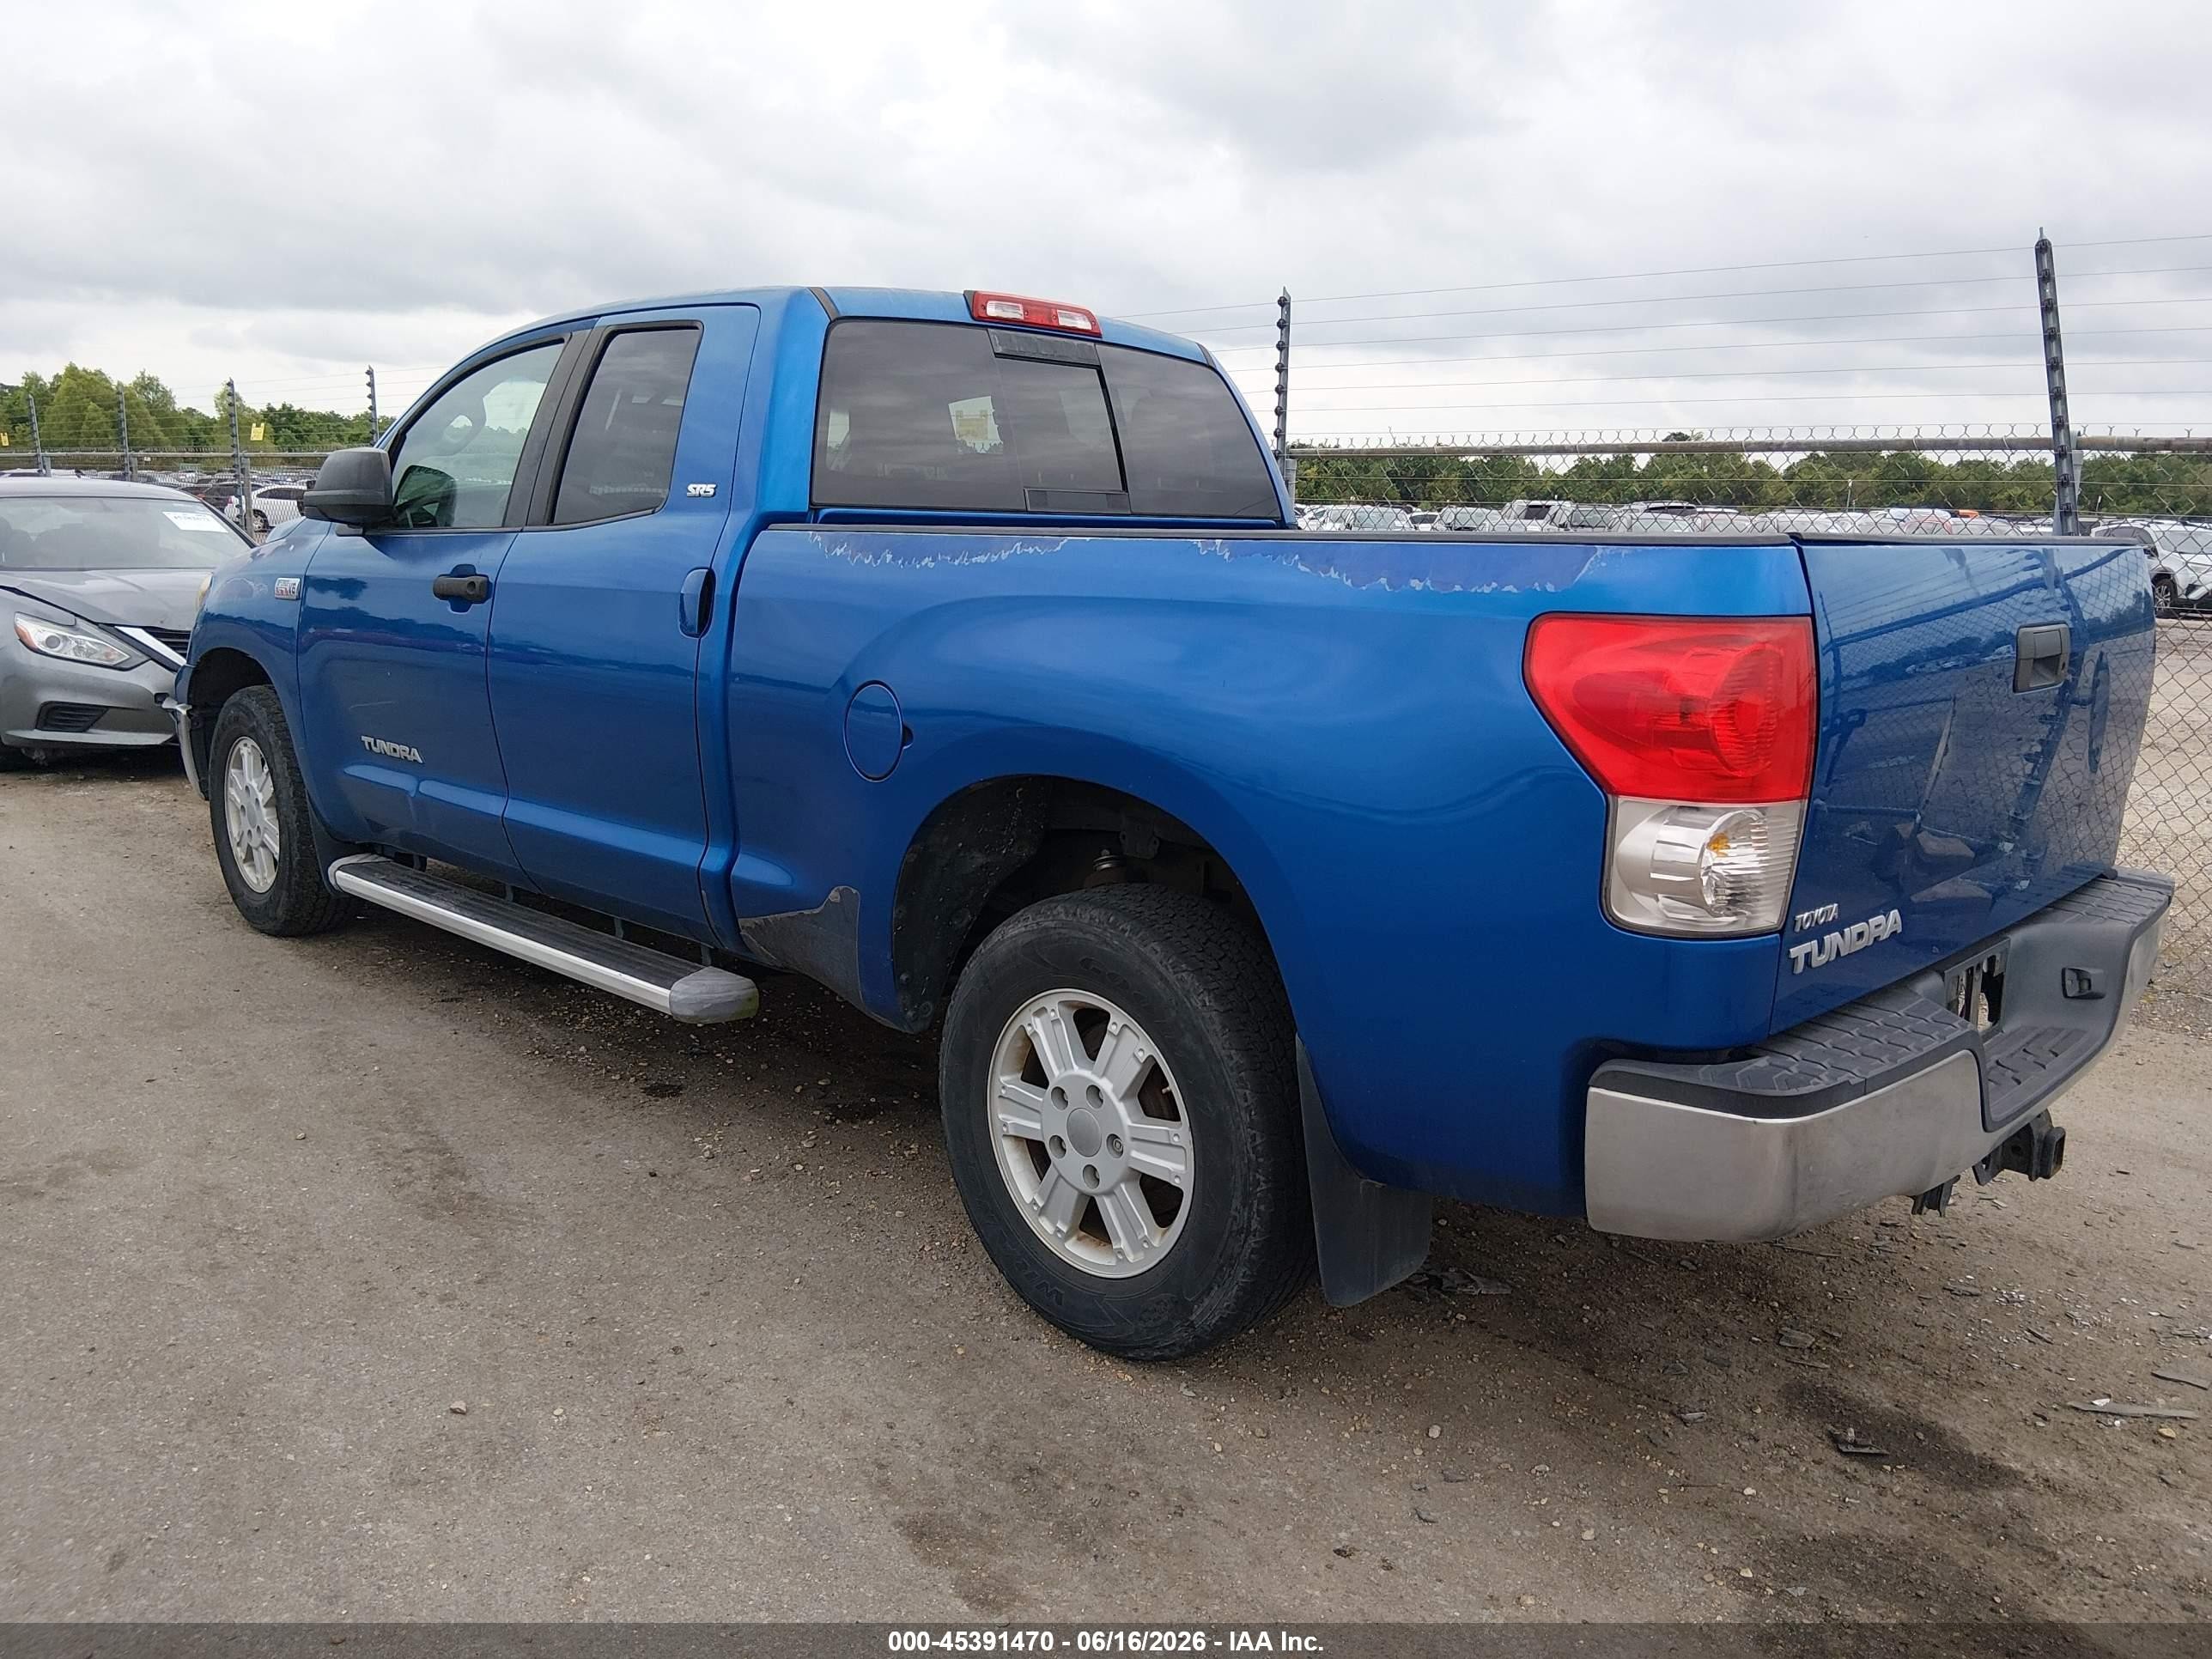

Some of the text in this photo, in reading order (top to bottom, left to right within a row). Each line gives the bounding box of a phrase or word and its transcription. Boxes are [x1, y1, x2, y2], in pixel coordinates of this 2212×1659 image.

[687, 483, 716, 497] SR5
[361, 735, 423, 763] TUNDRA
[1795, 903, 1839, 933] TOYOTA
[1789, 909, 1903, 975] TUNDRA
